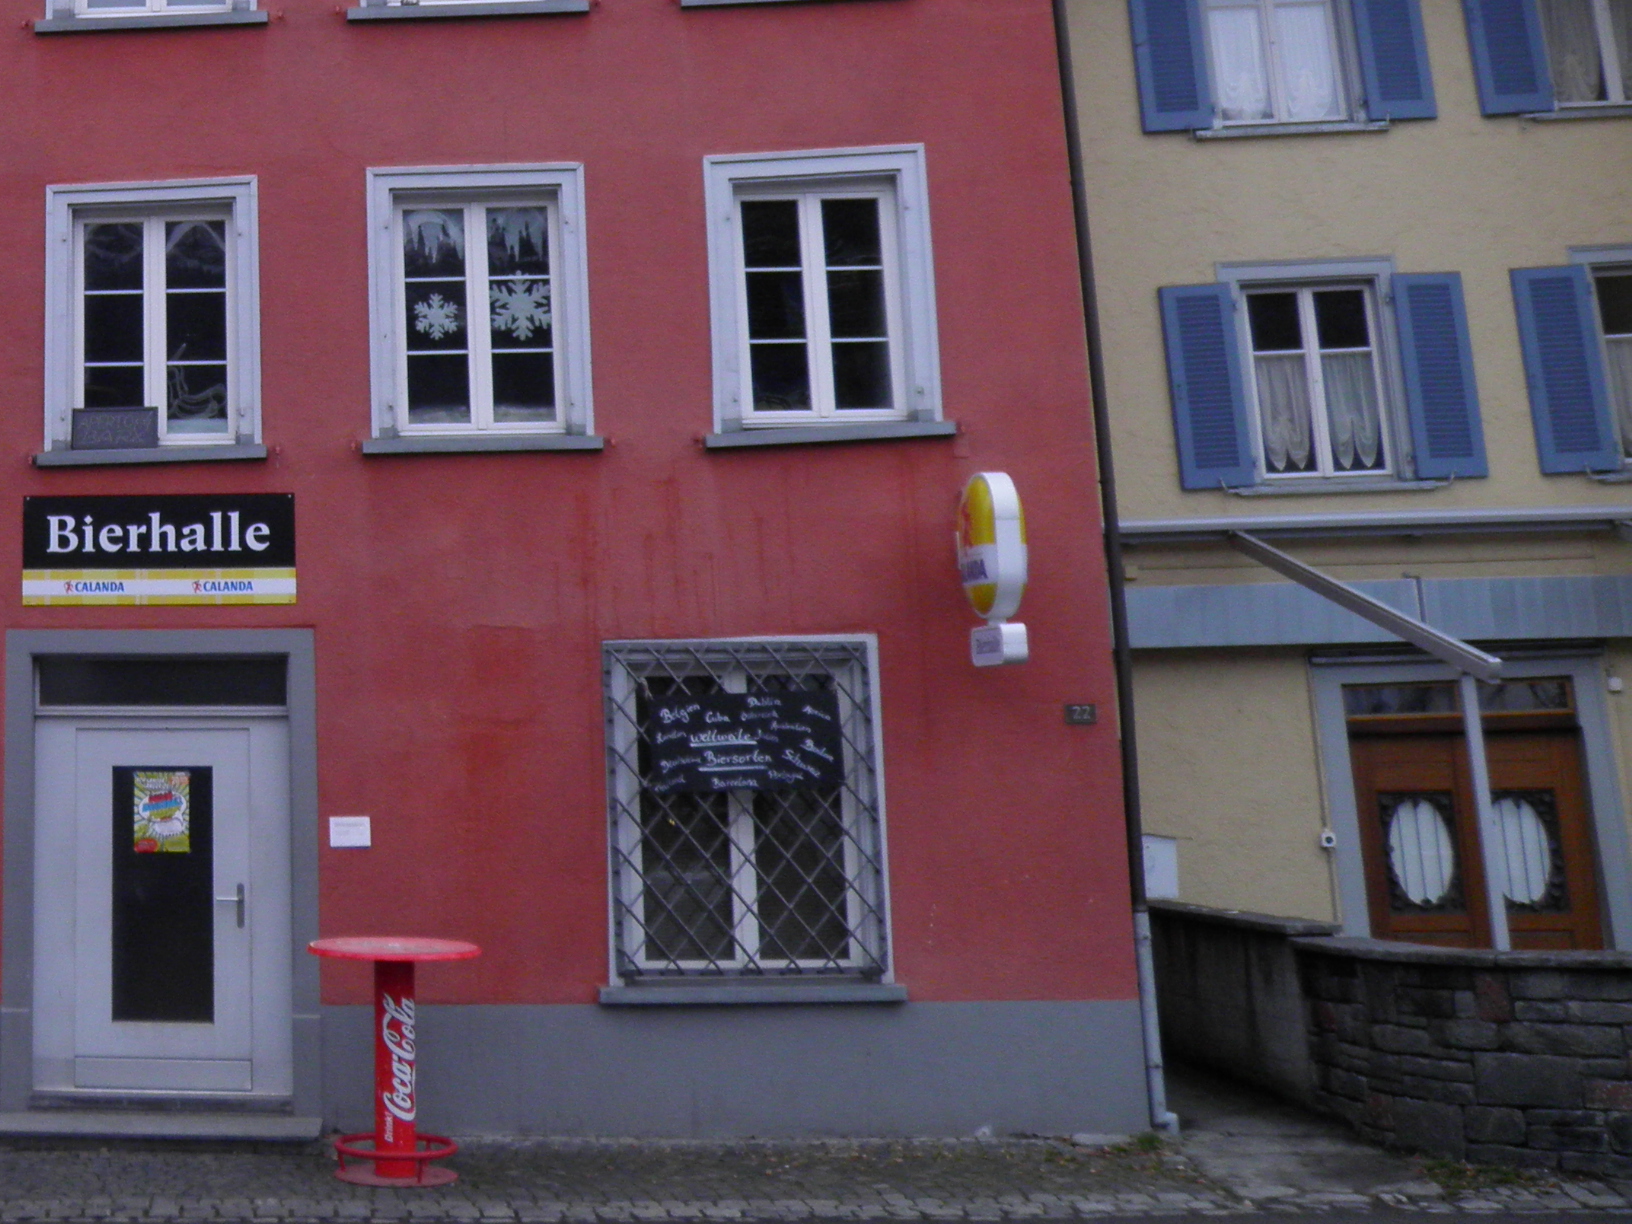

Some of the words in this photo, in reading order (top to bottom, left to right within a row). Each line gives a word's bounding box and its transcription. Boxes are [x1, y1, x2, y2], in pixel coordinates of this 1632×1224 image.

[46, 511, 270, 553] Bierhalle
[74, 581, 125, 593] CALANDA
[203, 580, 254, 592] CALANDA
[705, 710, 731, 724] Cuba
[1072, 705, 1091, 719] 22
[703, 749, 772, 766] Biersorten
